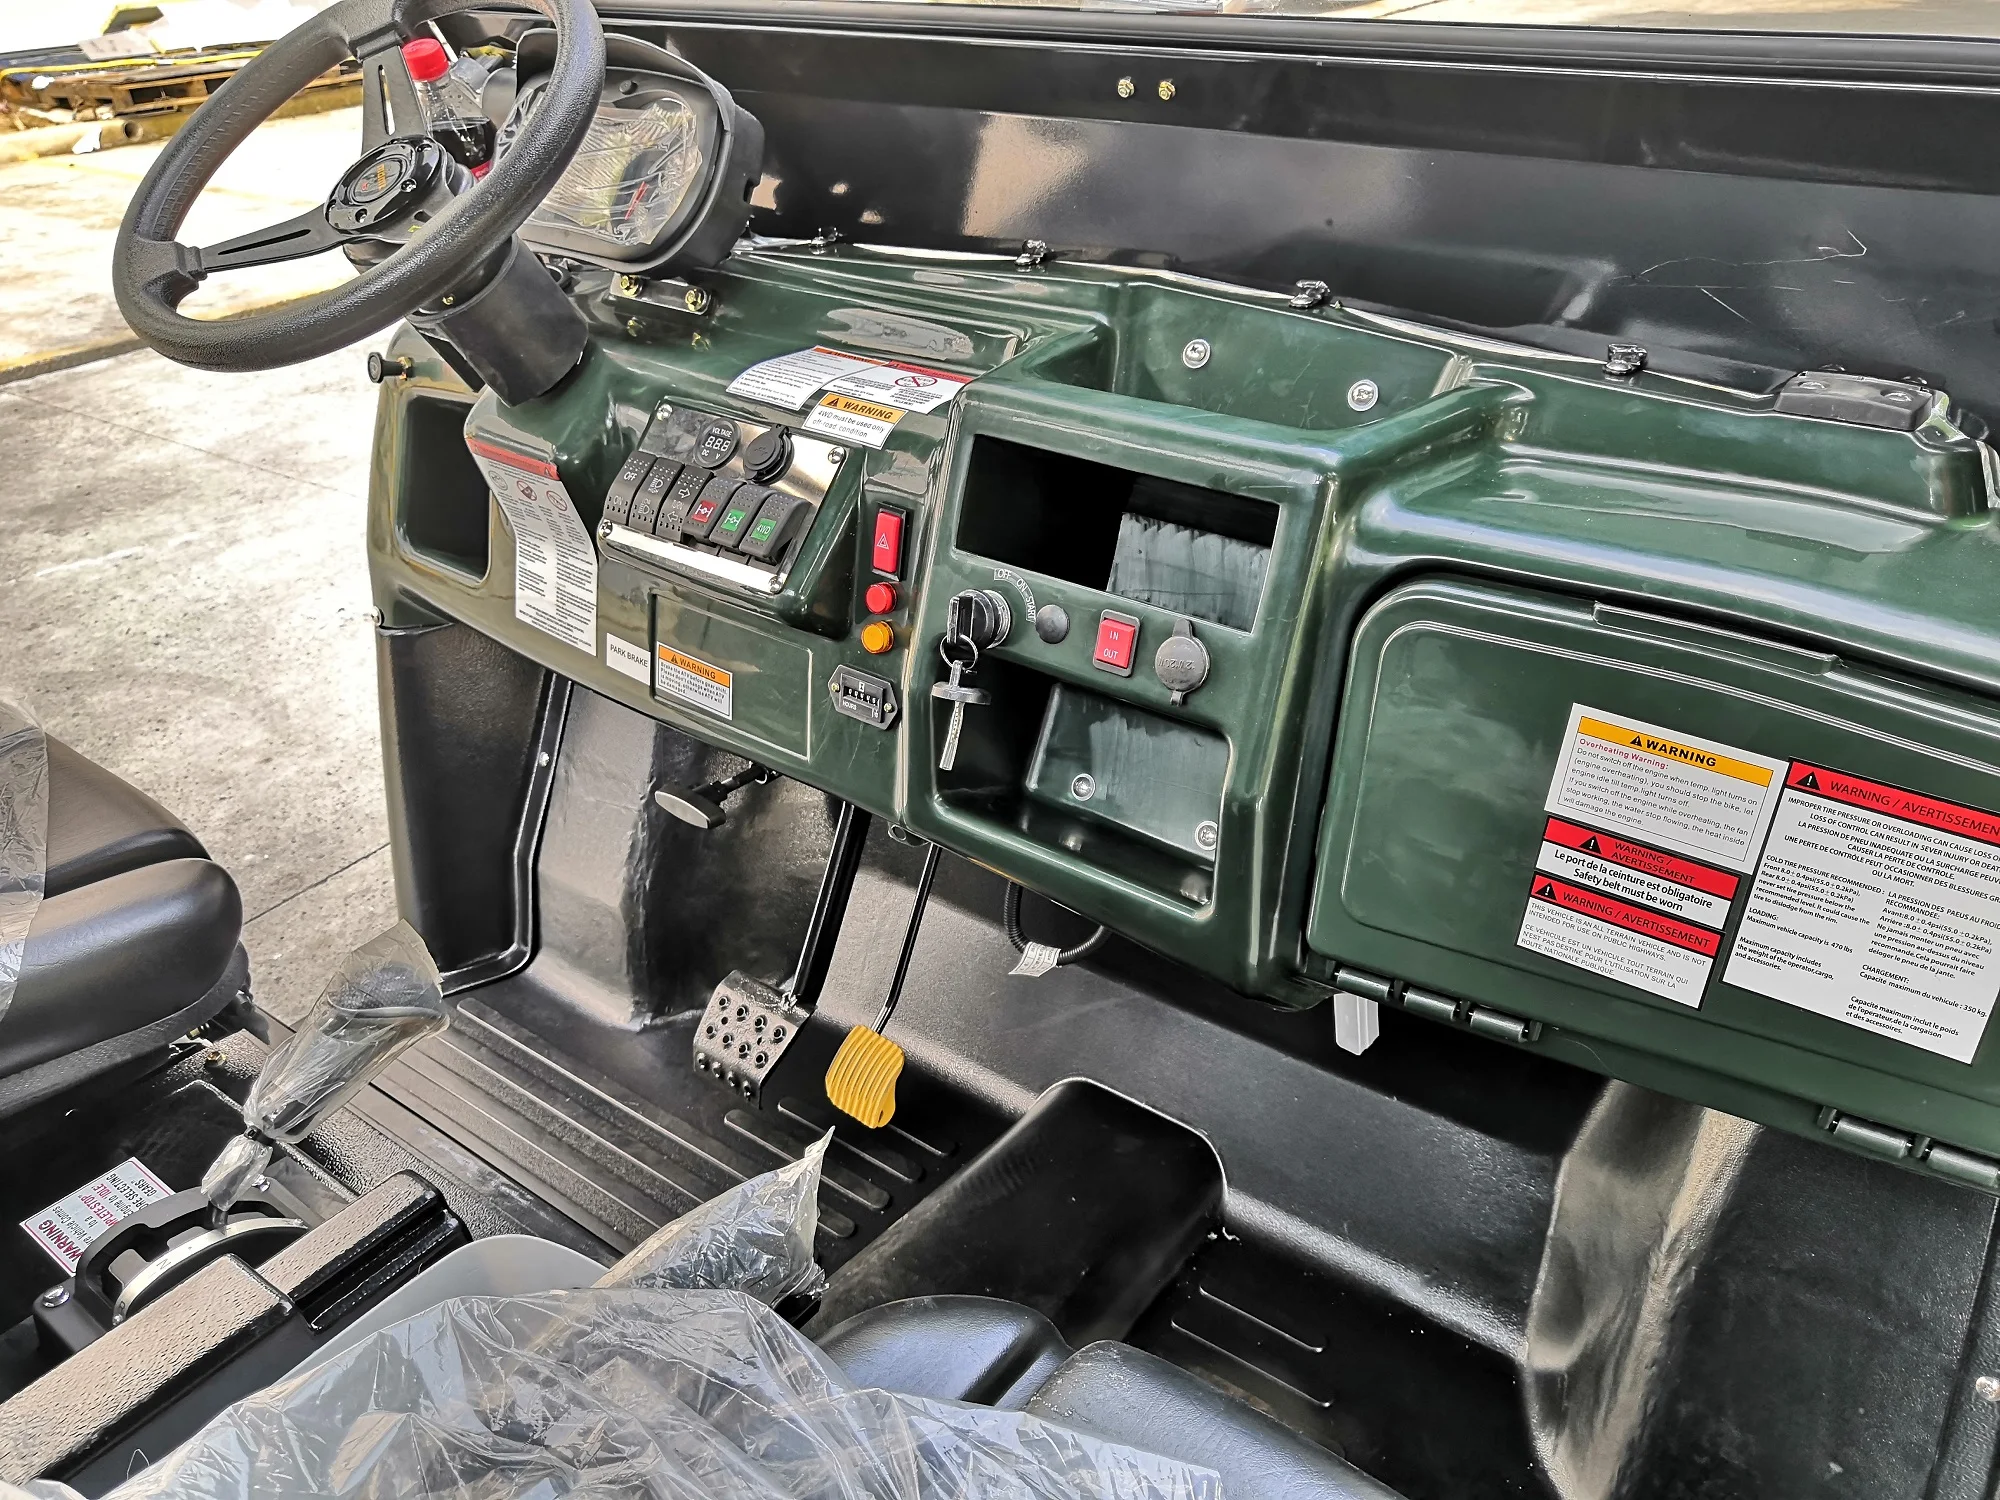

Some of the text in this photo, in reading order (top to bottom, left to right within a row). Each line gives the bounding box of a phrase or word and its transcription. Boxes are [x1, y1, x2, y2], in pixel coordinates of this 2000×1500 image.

[818, 410, 833, 419] 4WD
[833, 414, 847, 422] must
[857, 420, 872, 429] used
[872, 423, 885, 434] only
[843, 401, 893, 419] WARNING
[713, 427, 732, 437] VOLTAGE
[838, 425, 868, 438] condition
[624, 471, 637, 481] OFF
[614, 495, 623, 505] ON
[756, 523, 771, 535] 4WD
[997, 569, 1012, 579] OFF
[1016, 579, 1027, 592] ON
[1026, 596, 1036, 622] START
[1110, 631, 1119, 640] IN
[610, 644, 648, 668] PARK BRAKE
[1103, 648, 1118, 660] OUT
[679, 658, 716, 679] WARNING
[1579, 738, 1668, 769] Overheating Warning:
[1646, 739, 1716, 766] WARNING
[1576, 747, 1587, 755] Do
[1599, 755, 1621, 765] switch
[1632, 763, 1643, 772] the
[1644, 768, 1668, 779] engine
[1669, 775, 1689, 785] when
[1711, 786, 1727, 796] light
[1728, 792, 1746, 802] turns
[1665, 785, 1691, 796] should
[1691, 793, 1708, 802] stop
[1709, 797, 1722, 806] the
[1830, 780, 1891, 807] WARNING
[1787, 796, 1822, 810] IMPROPER
[1822, 806, 1836, 815] TIRE
[1836, 810, 1870, 824] PRESSURE
[1882, 823, 1932, 842] OVERLOADING
[1932, 838, 1948, 846] CAN
[1949, 842, 1972, 853] CAUSE
[1973, 849, 1992, 859] LOSS
[1809, 812, 1826, 822] LOSS
[1837, 821, 1868, 834] CONTROL
[1869, 830, 1885, 839] CAN
[1885, 834, 1910, 846] RESULT
[1920, 844, 1942, 855] SEVER
[1942, 851, 1969, 862] INJURY
[1969, 858, 1980, 866] OR
[1615, 841, 1664, 863] WARNING
[1554, 849, 1712, 908] Le port de la ceinture est obligatoire
[1611, 851, 1694, 883] AVERTISSEMENT
[1766, 854, 1881, 893] COLD TIRE PRESSURE RECOMMENDED
[1573, 868, 1682, 911] Safety belt must be worn
[1758, 878, 1776, 887] never
[1796, 890, 1824, 902] pressure
[1824, 897, 1844, 908] below
[1563, 891, 1710, 947] WARNING AVERTISSEMENT
[1748, 906, 1778, 920] LOADING:
[1528, 909, 1560, 924] INTENDED
[1561, 920, 1575, 929] FOR
[1576, 925, 1590, 935] USE
[1603, 934, 1627, 947] PUBLIC
[1531, 902, 1545, 911] THIS
[1547, 907, 1574, 921] VEHICLE
[1592, 924, 1604, 932] ALL
[1606, 927, 1636, 942] TERRAIN
[1638, 938, 1665, 952] VEHICLE
[1666, 949, 1681, 957] AND
[1691, 957, 1706, 966] NOT
[1746, 914, 1775, 928] Maximum
[1776, 925, 1797, 935] vehicle
[1797, 932, 1823, 944] capacity
[1843, 945, 1852, 953] lbs
[1862, 964, 1909, 983] CHARGEMENT:
[107, 1173, 138, 1201] SELECTING
[108, 1195, 118, 1205] to
[52, 1206, 87, 1243] Vehicle Comes
[88, 1220, 98, 1228] to
[38, 1219, 84, 1263] WARNING
